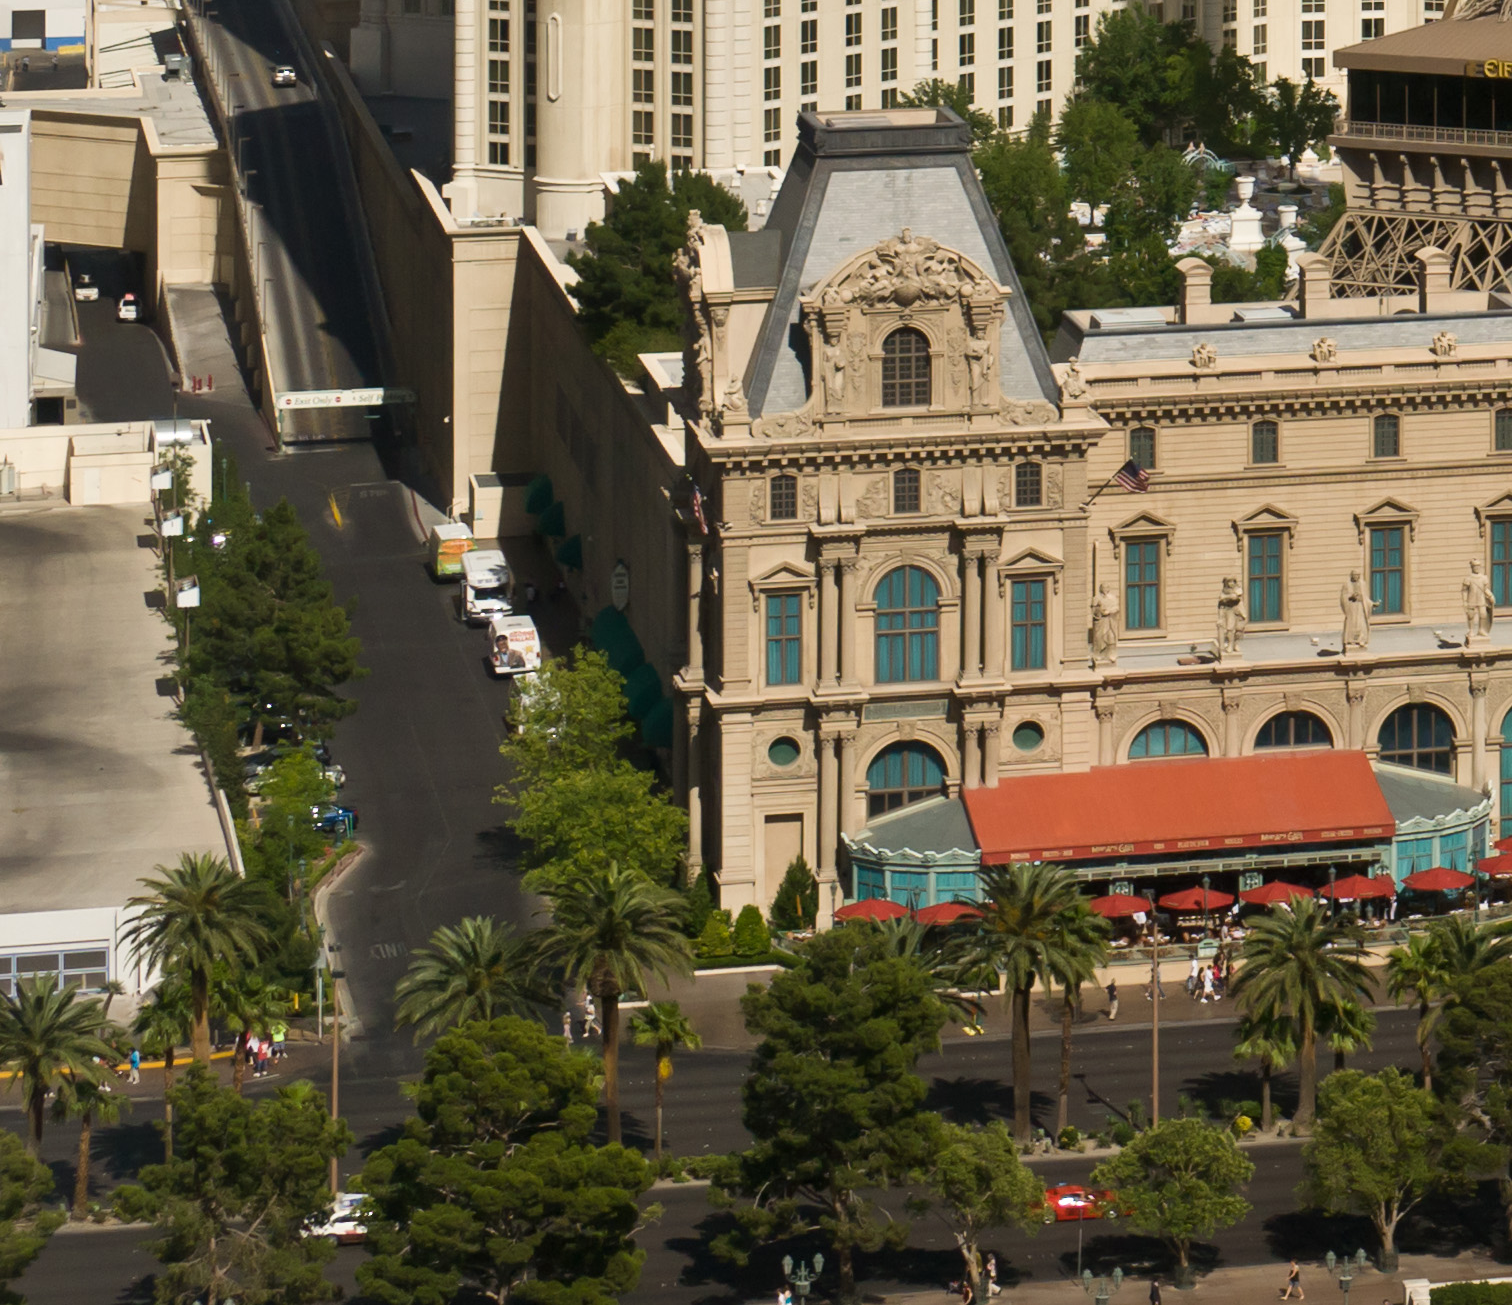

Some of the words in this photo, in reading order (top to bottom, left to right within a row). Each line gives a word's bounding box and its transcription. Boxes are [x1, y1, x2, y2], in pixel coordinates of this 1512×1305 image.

[294, 397, 311, 406] Exit
[313, 395, 332, 405] Only
[359, 393, 374, 402] Self
